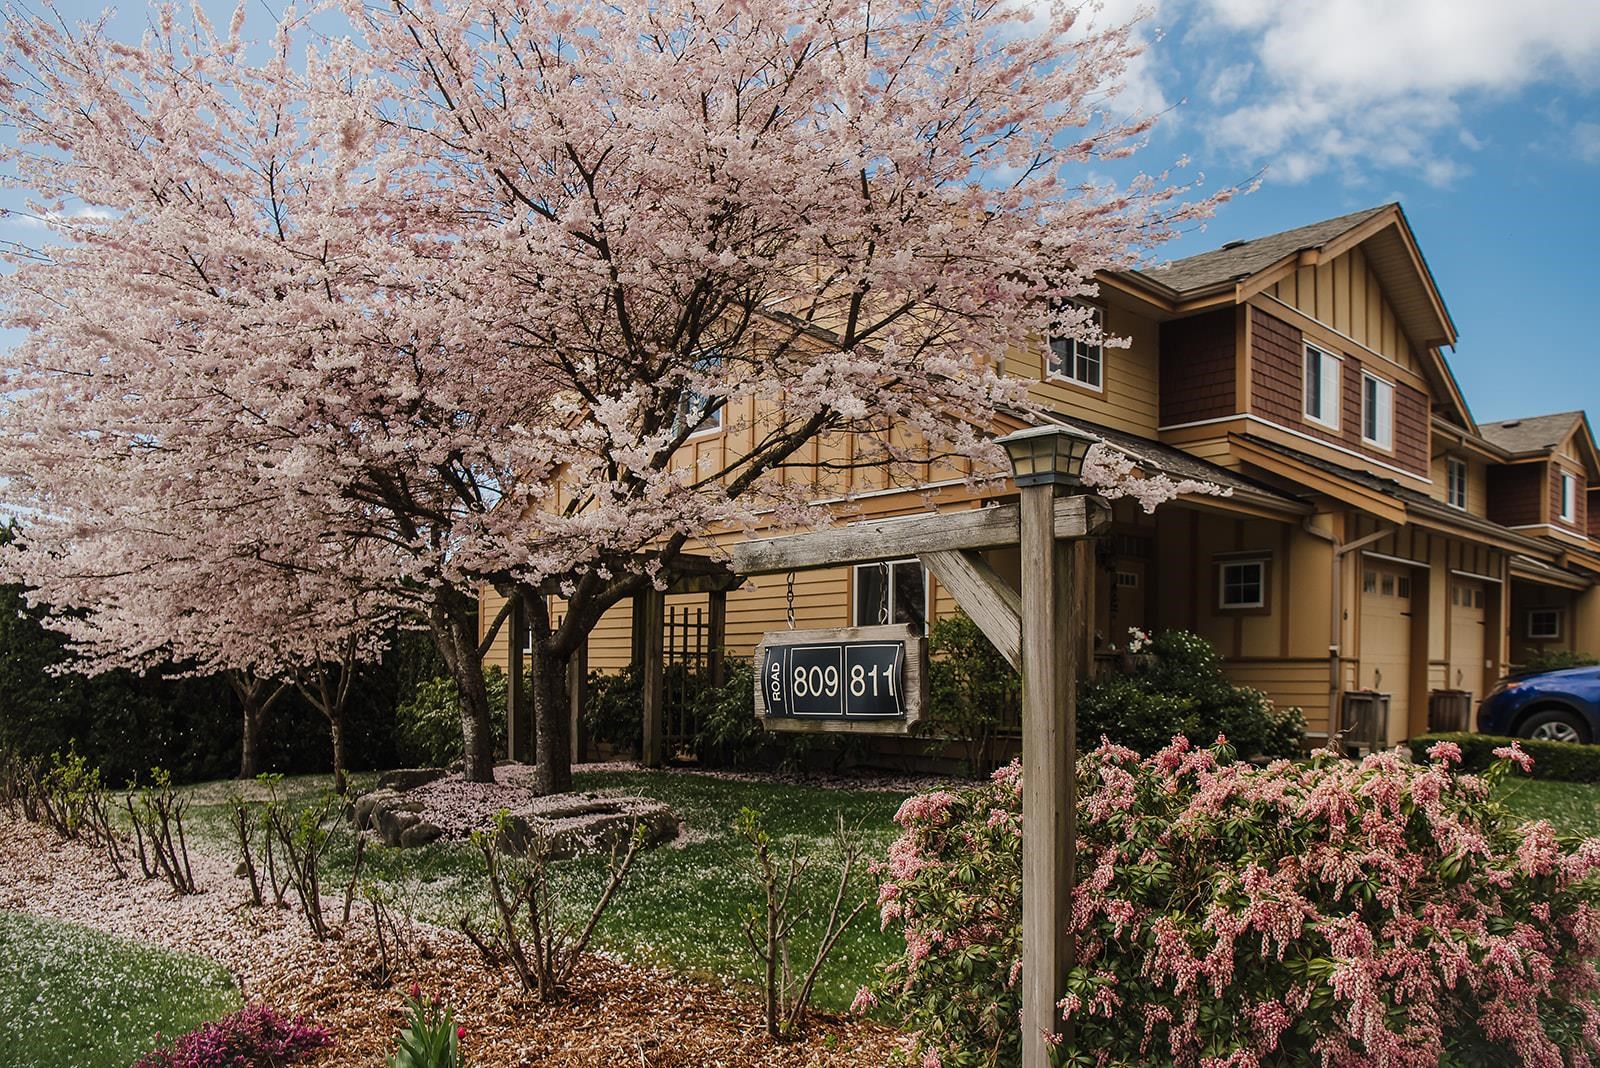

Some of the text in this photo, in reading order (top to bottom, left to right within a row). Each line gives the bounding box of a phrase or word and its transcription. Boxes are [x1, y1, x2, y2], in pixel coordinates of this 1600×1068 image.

[771, 662, 781, 701] ROAD
[794, 665, 839, 697] 809
[850, 664, 894, 697] 811
